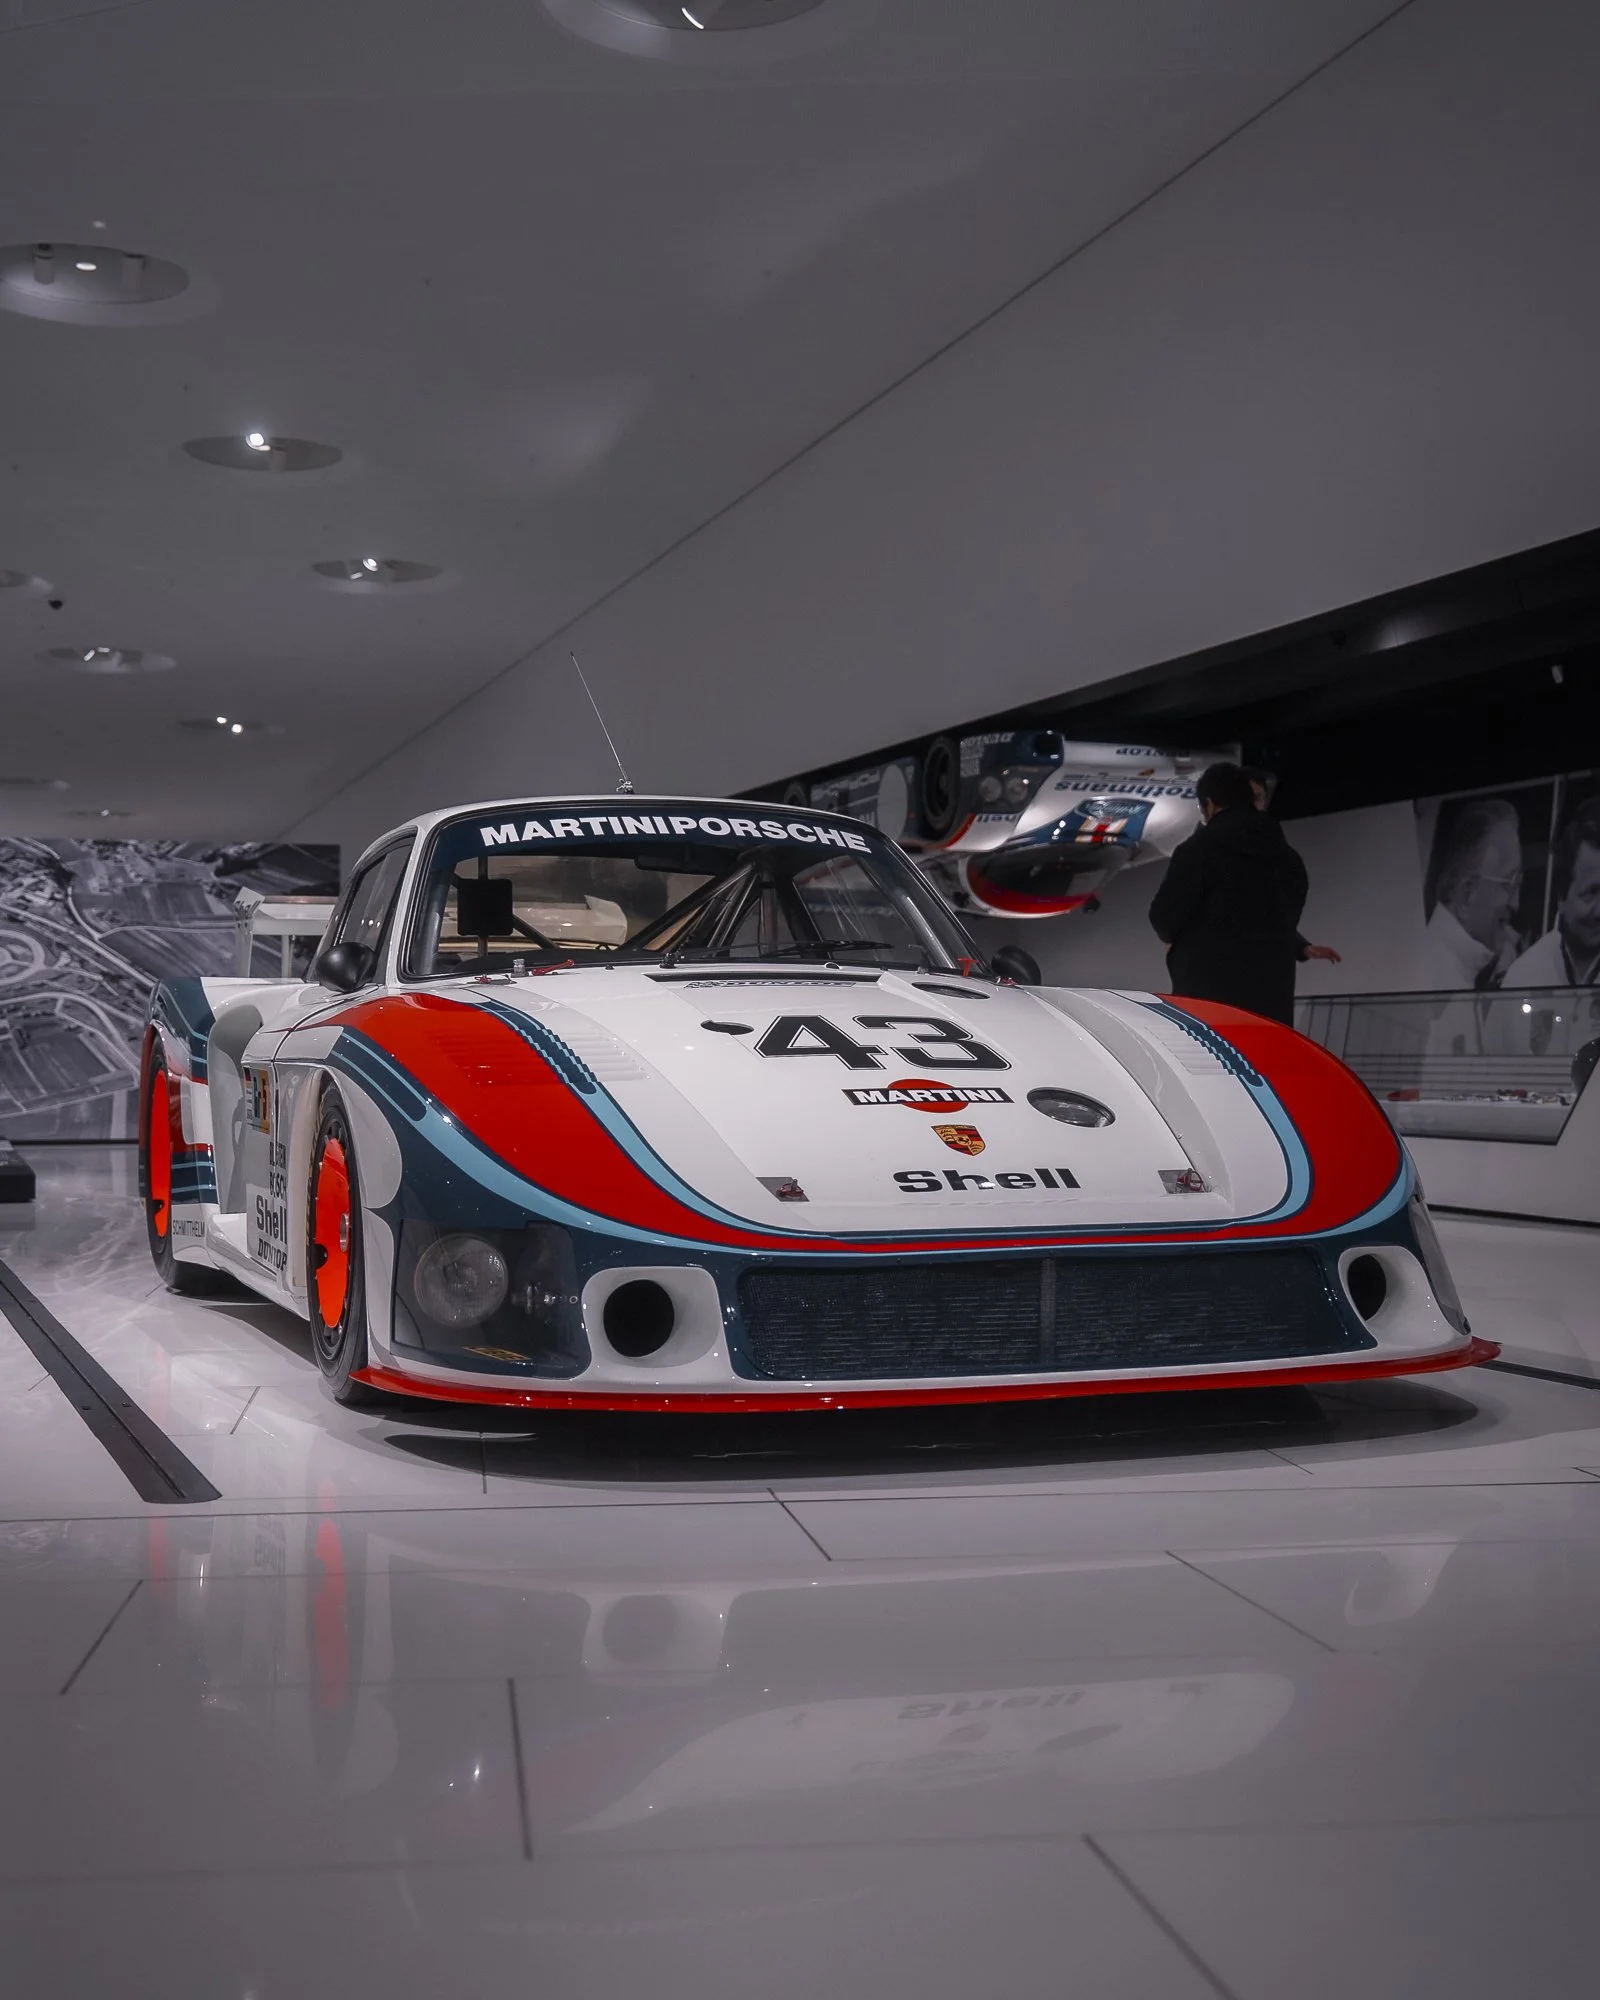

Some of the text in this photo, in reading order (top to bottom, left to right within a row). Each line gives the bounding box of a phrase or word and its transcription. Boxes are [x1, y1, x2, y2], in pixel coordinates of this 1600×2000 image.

[753, 1015, 1012, 1071] 43
[852, 1088, 1004, 1104] MARTINI
[892, 1167, 1082, 1193] Shell
[256, 1195, 287, 1244] Shell
